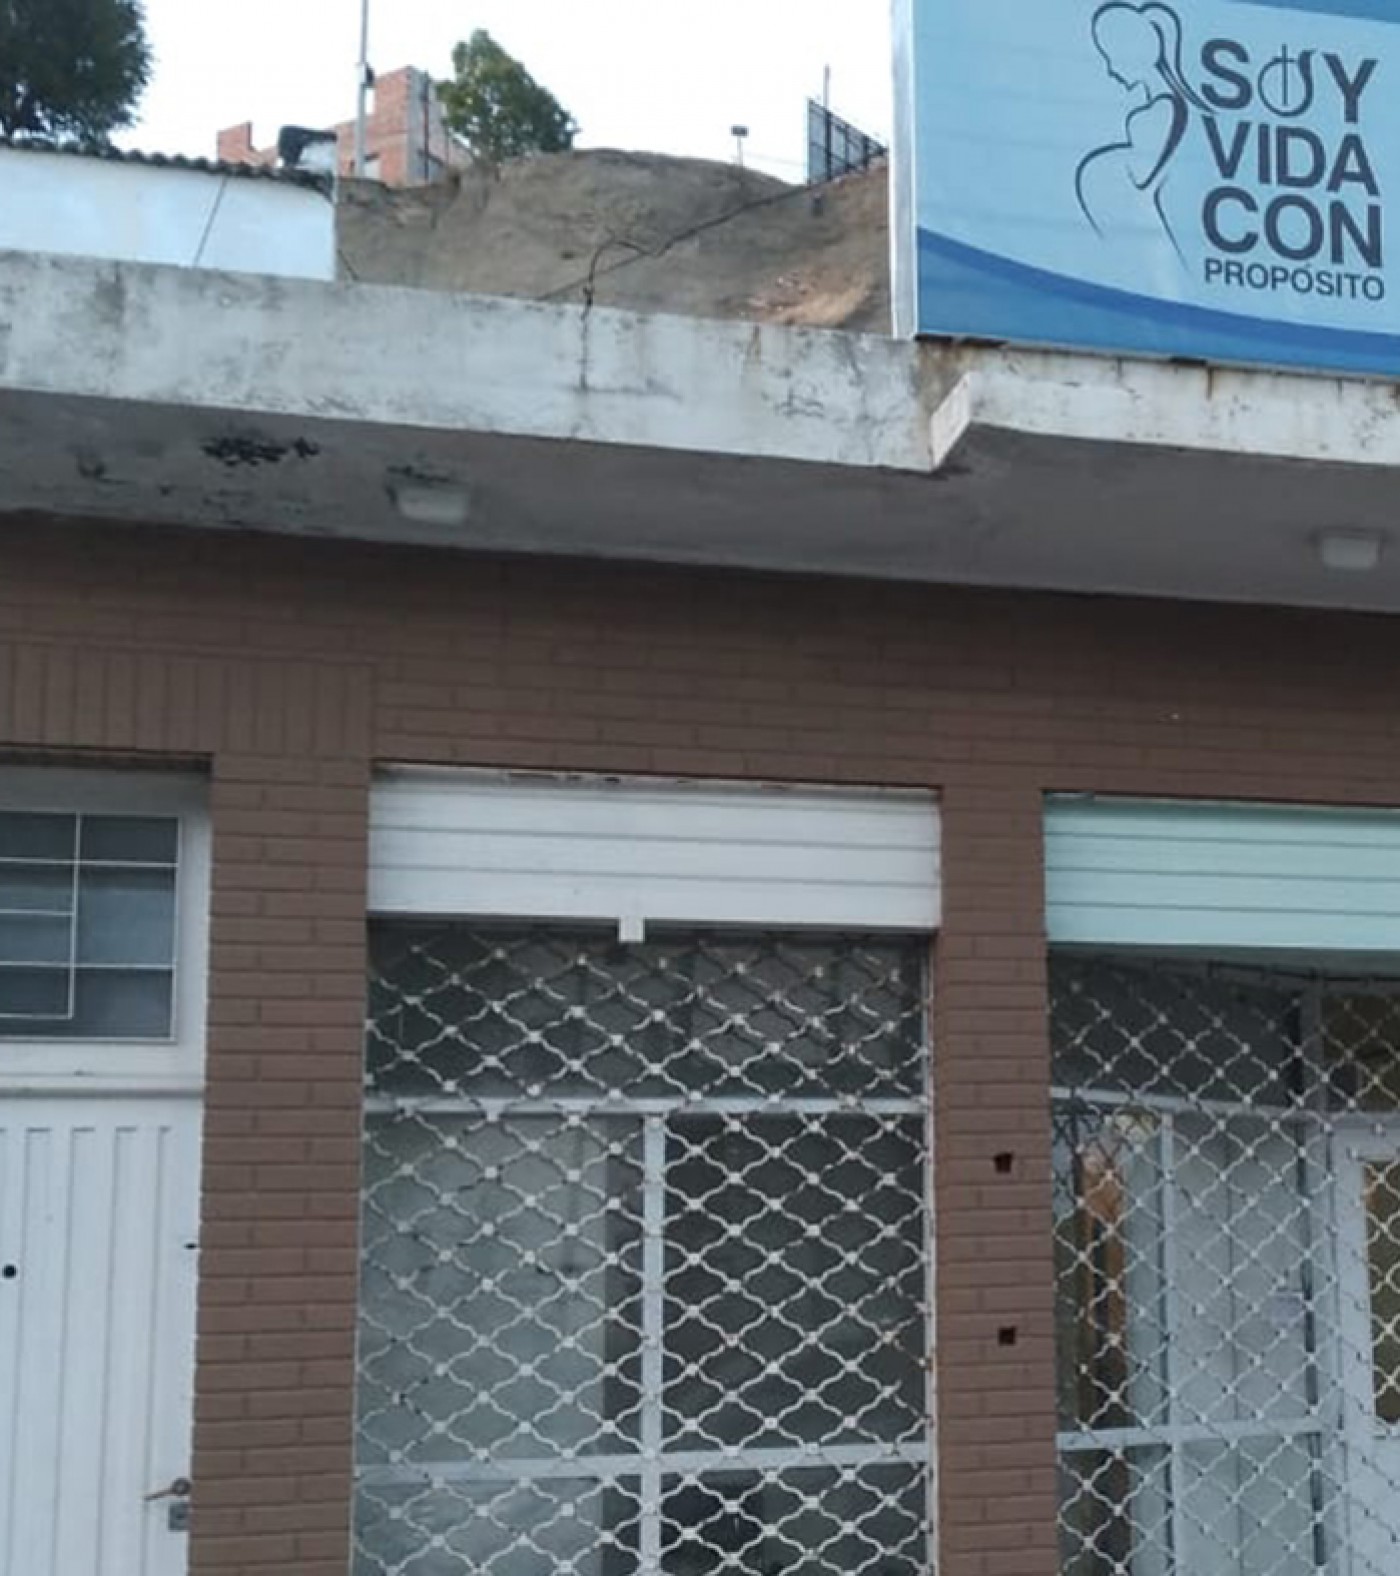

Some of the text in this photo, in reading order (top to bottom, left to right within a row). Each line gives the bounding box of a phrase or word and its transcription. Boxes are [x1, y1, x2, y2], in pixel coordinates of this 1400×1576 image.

[1200, 38, 1378, 124] SOY
[1202, 114, 1381, 196] VIDA
[1202, 186, 1384, 269] CON
[1204, 258, 1386, 300] PROPÓSITO
